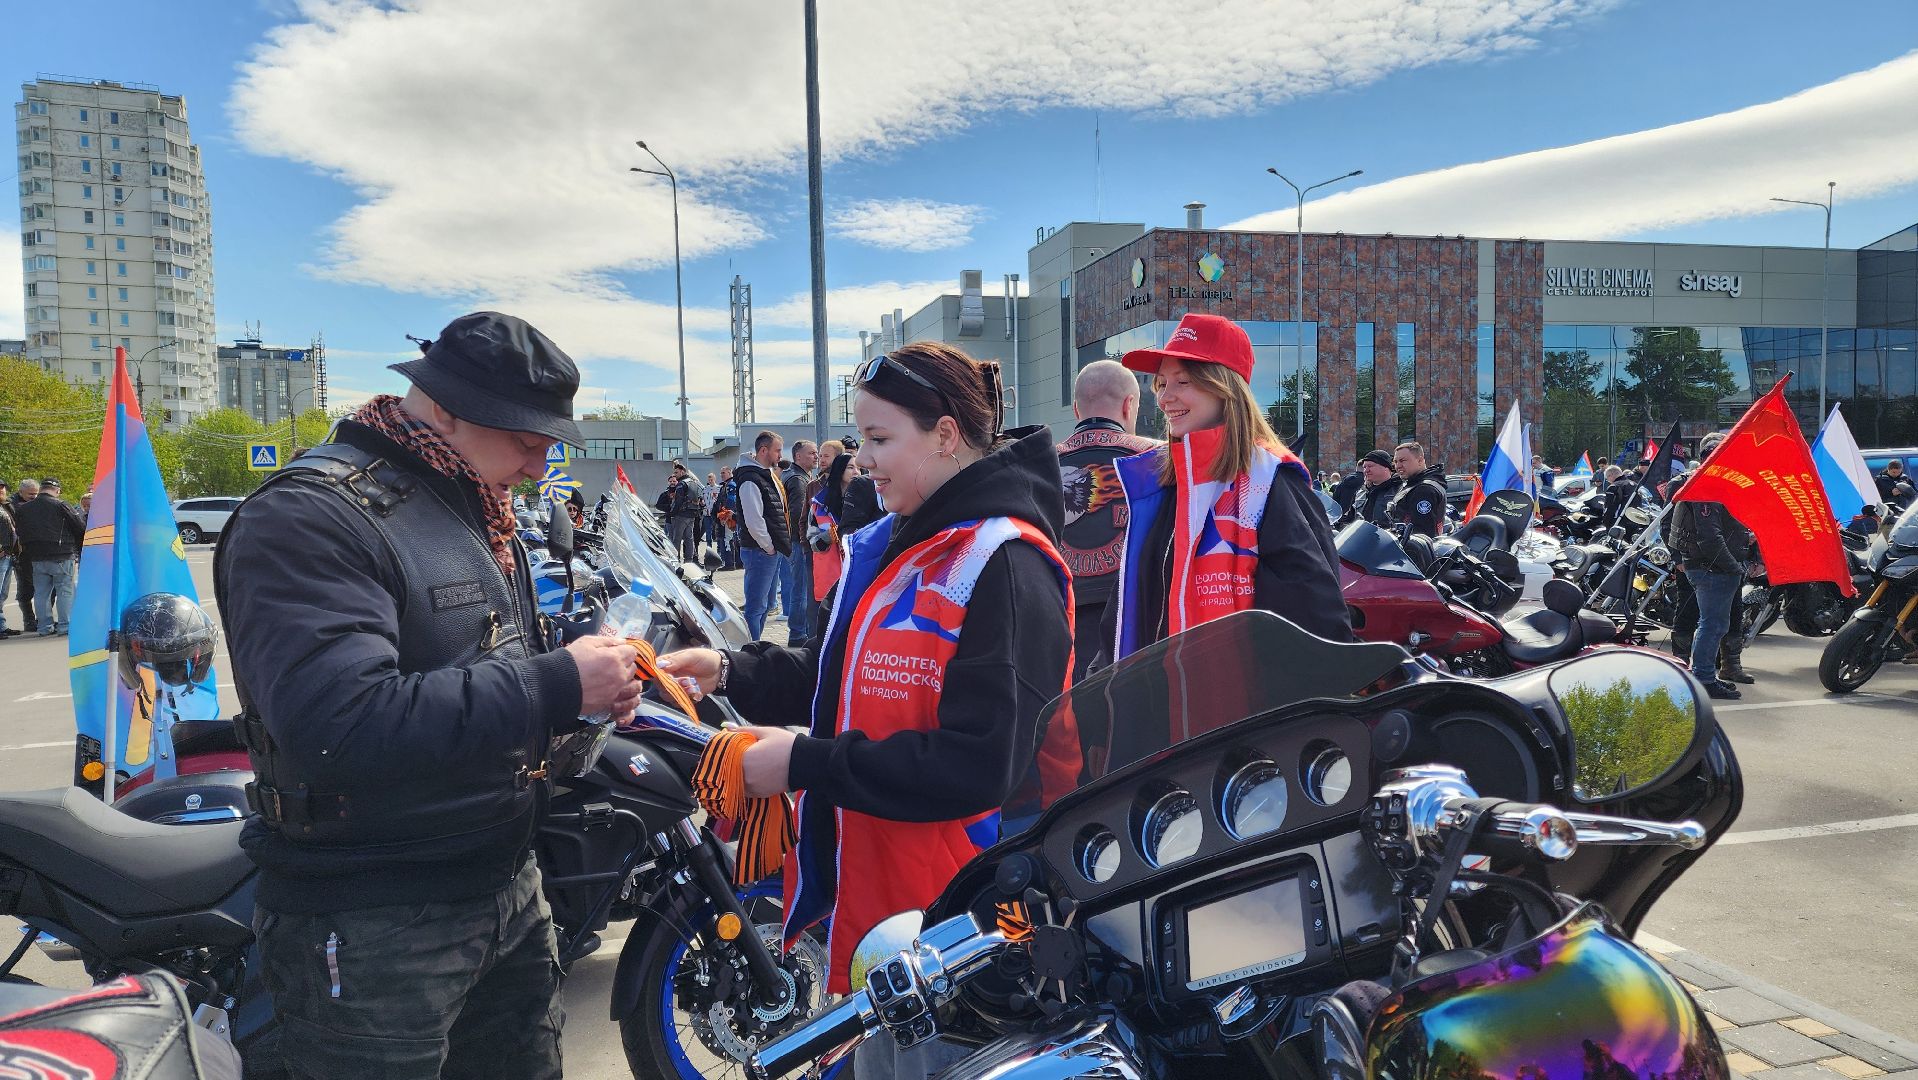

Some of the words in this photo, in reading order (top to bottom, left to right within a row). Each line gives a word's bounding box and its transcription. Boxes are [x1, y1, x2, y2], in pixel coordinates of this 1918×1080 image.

[1547, 268, 1597, 288] SILVER
[1602, 269, 1653, 288] CINEMA
[1680, 269, 1742, 298] sinsay
[1547, 288, 1574, 297] СЕТЬ
[1579, 288, 1654, 298] КИНОТЕАТРОВ
